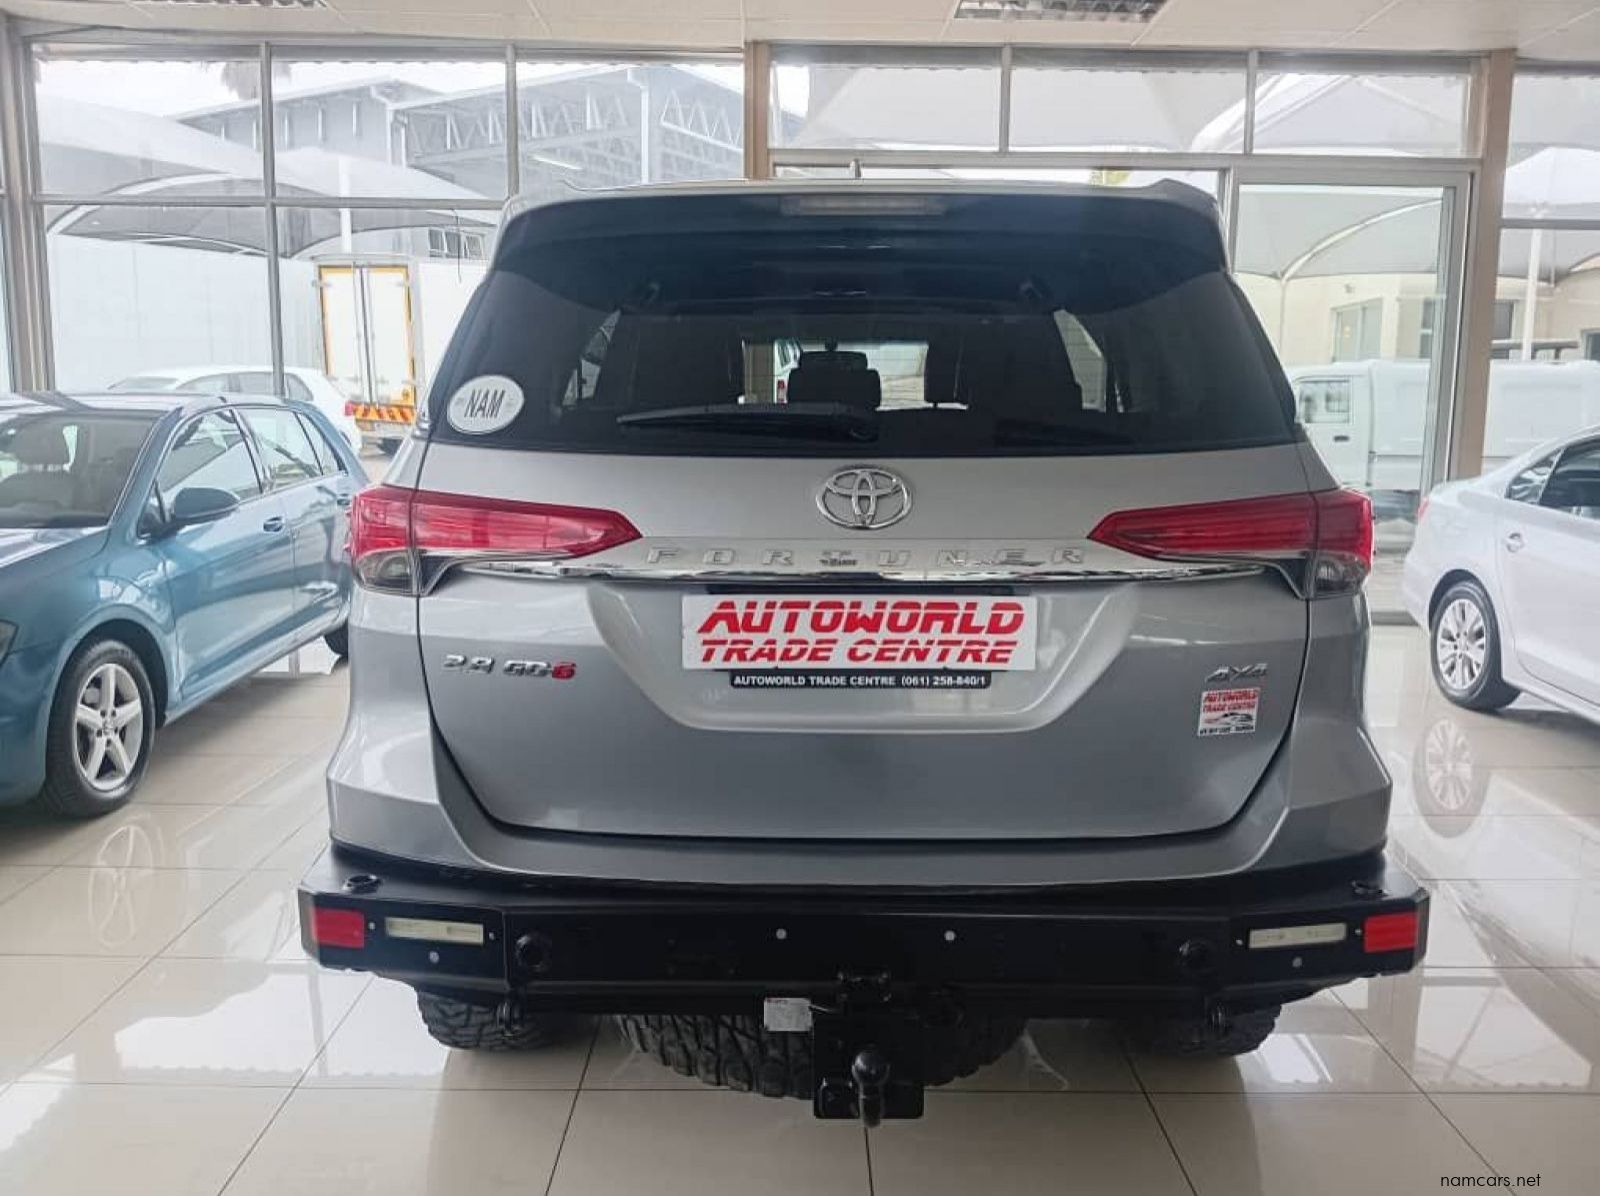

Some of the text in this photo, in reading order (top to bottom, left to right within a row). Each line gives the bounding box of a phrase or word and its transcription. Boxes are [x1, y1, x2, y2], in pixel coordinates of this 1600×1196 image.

[464, 388, 506, 418] NAM
[647, 547, 1087, 567] FORTUNER
[697, 600, 1024, 634] AUTOWORLD
[701, 638, 1018, 663] TRADE CENTRE
[733, 675, 806, 687] AUTOWORLD
[809, 675, 847, 686] TRADE
[850, 675, 896, 686] CENTRE
[901, 675, 930, 687] (061)
